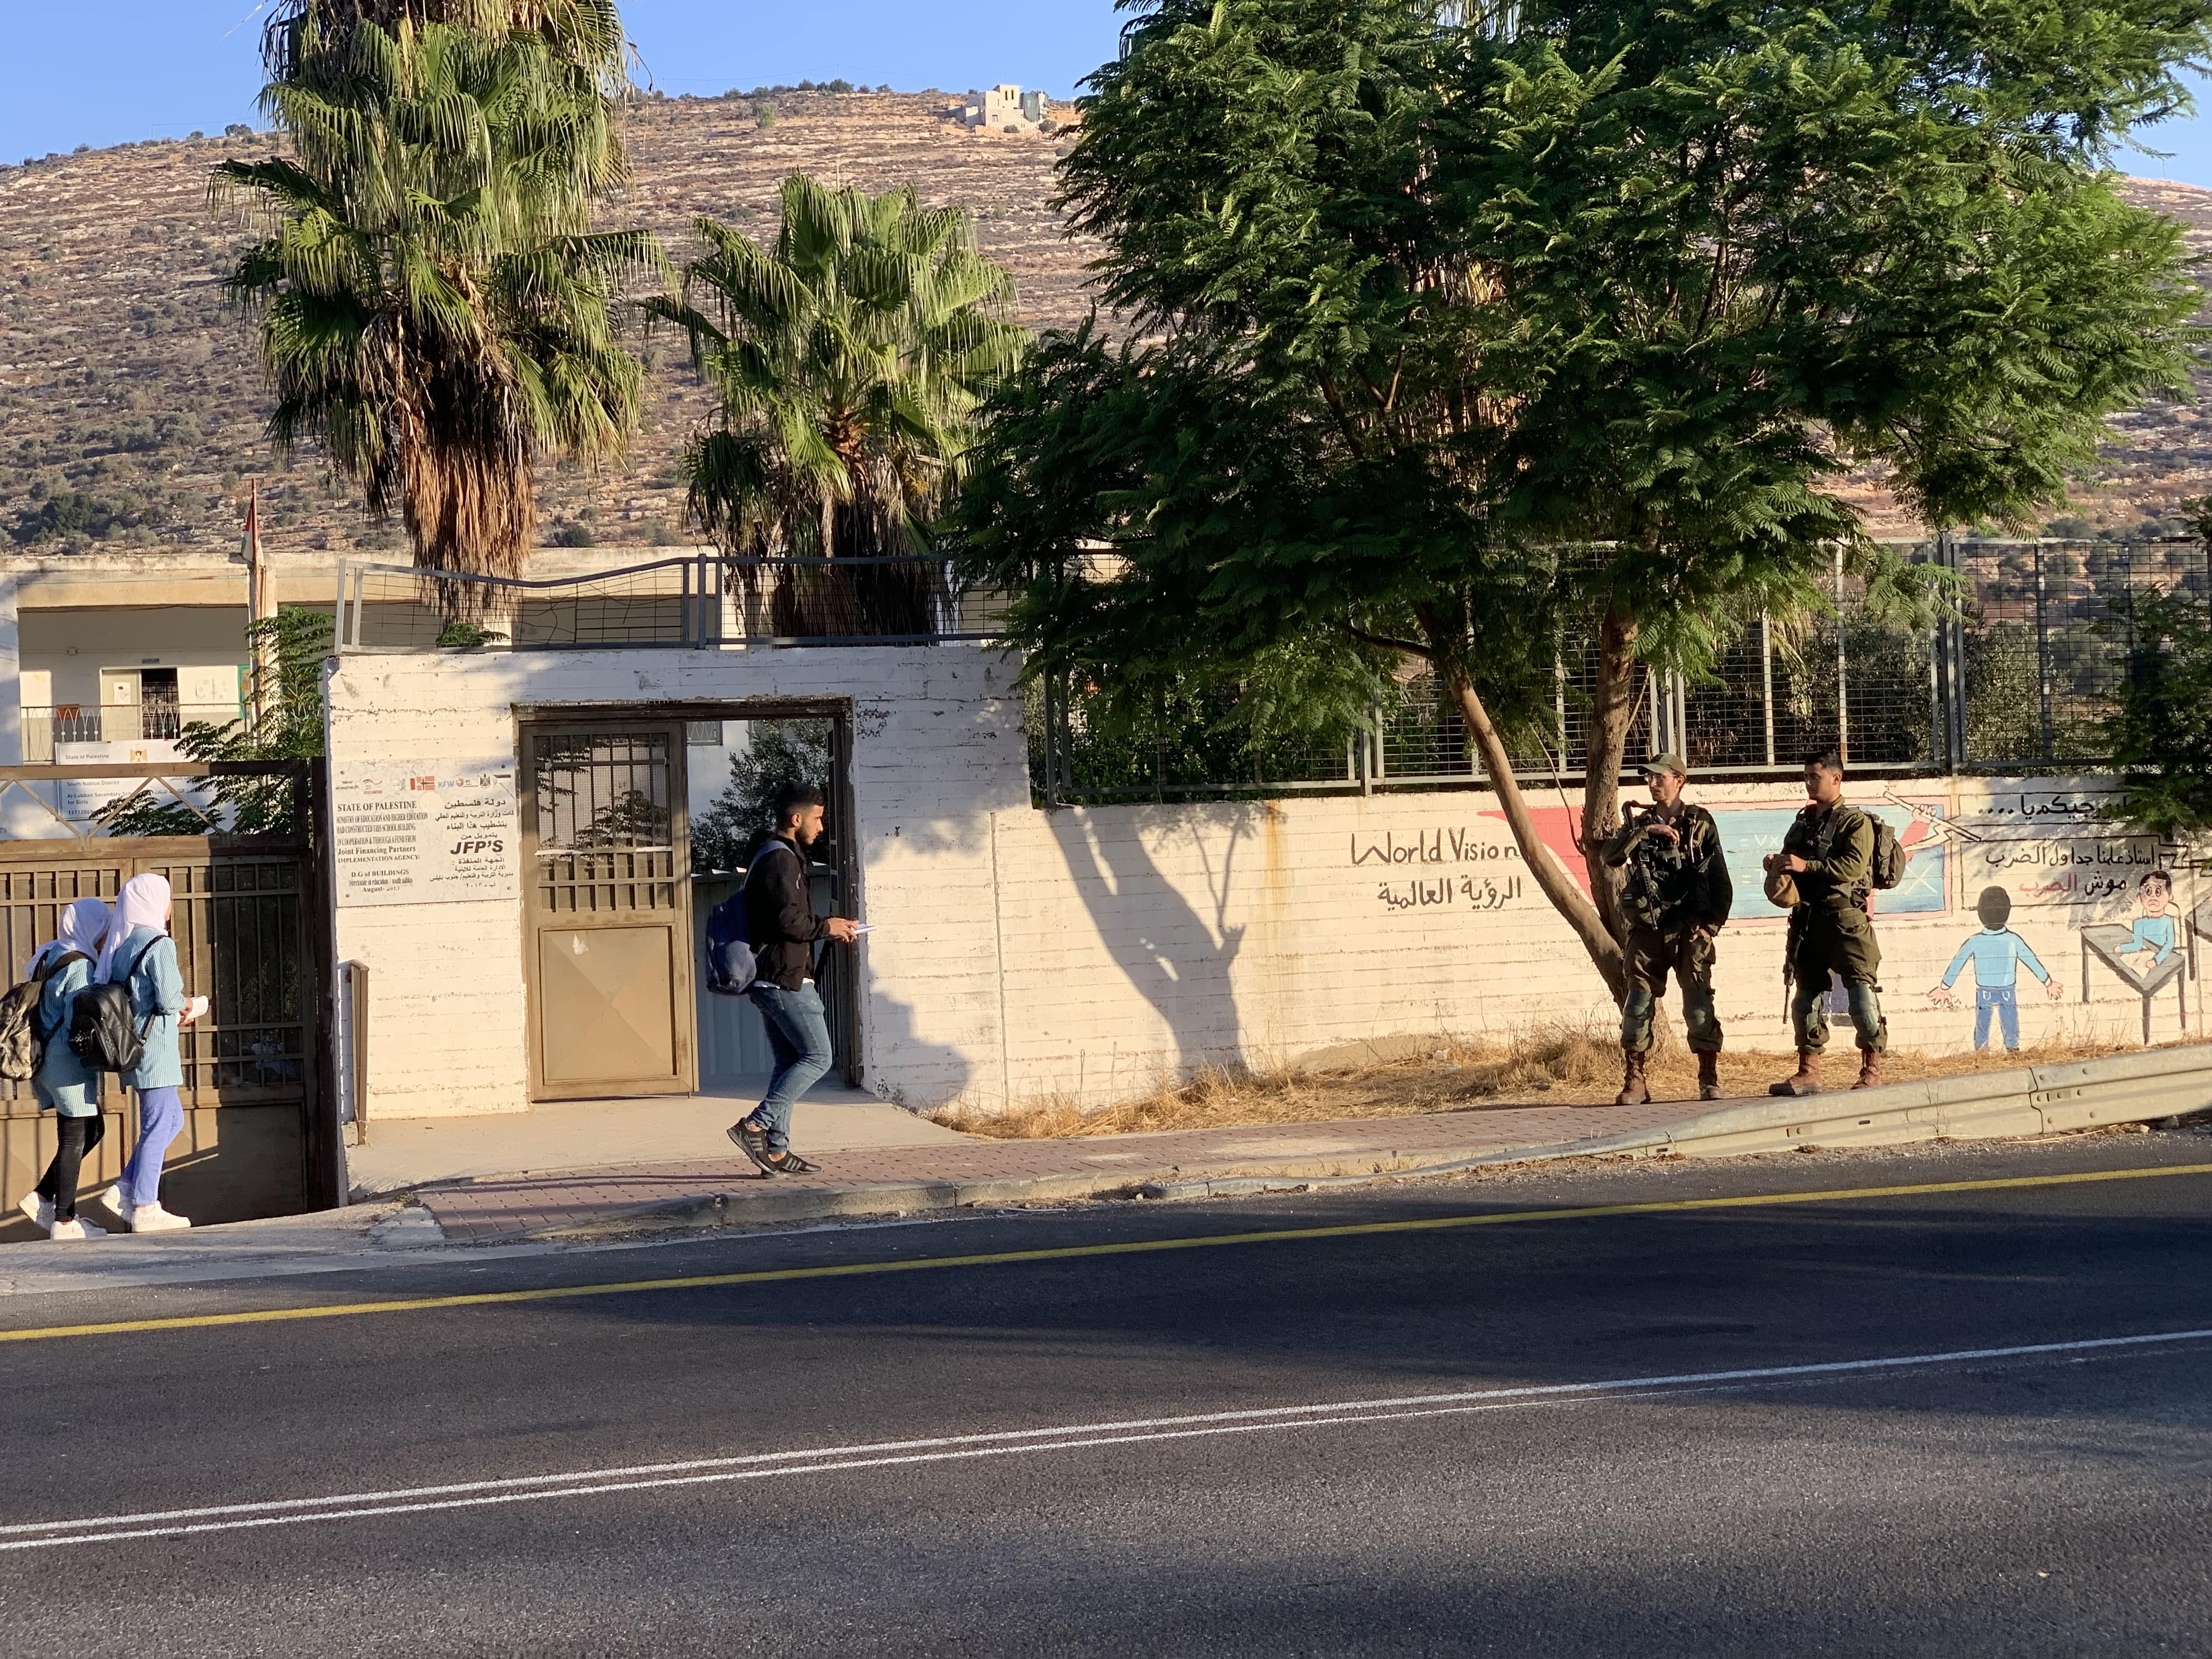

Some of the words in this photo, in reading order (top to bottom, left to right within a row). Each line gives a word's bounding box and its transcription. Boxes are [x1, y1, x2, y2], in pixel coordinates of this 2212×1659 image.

[337, 803, 361, 812] STATE
[363, 802, 373, 811] OF
[375, 800, 417, 810] PALESTINE
[444, 799, 481, 809] فلسطين
[484, 798, 506, 806] دولة
[336, 815, 354, 823] MINISTRY
[355, 815, 360, 823] OF
[360, 814, 382, 823] EDUCATION
[391, 813, 405, 822] HIGHER
[407, 812, 428, 821] EDUCATION
[337, 826, 345, 834] HAD
[345, 825, 373, 833] CONSTRUCTED
[373, 824, 382, 832] THIS
[382, 823, 397, 832] SCHOOL
[398, 823, 416, 831] BUILDING
[447, 822, 464, 831] البناء
[342, 837, 369, 845] COOPERATION
[373, 836, 392, 844] THROUGH
[395, 835, 405, 843] FUND
[405, 834, 416, 843] FROM
[1351, 827, 1442, 865] World
[1448, 827, 1520, 862] Vision
[356, 847, 387, 855] Financing
[1985, 845, 2046, 868] الضرب
[2049, 845, 2094, 866] جداول
[2097, 844, 2124, 866] علمنا
[2125, 844, 2155, 865] استاذ
[338, 855, 393, 864] IMPLEMENTATION
[2019, 872, 2078, 898] الضرب
[2085, 870, 2126, 896] موش
[1377, 878, 1452, 911] العالمية
[1462, 874, 1521, 910] الرؤية
